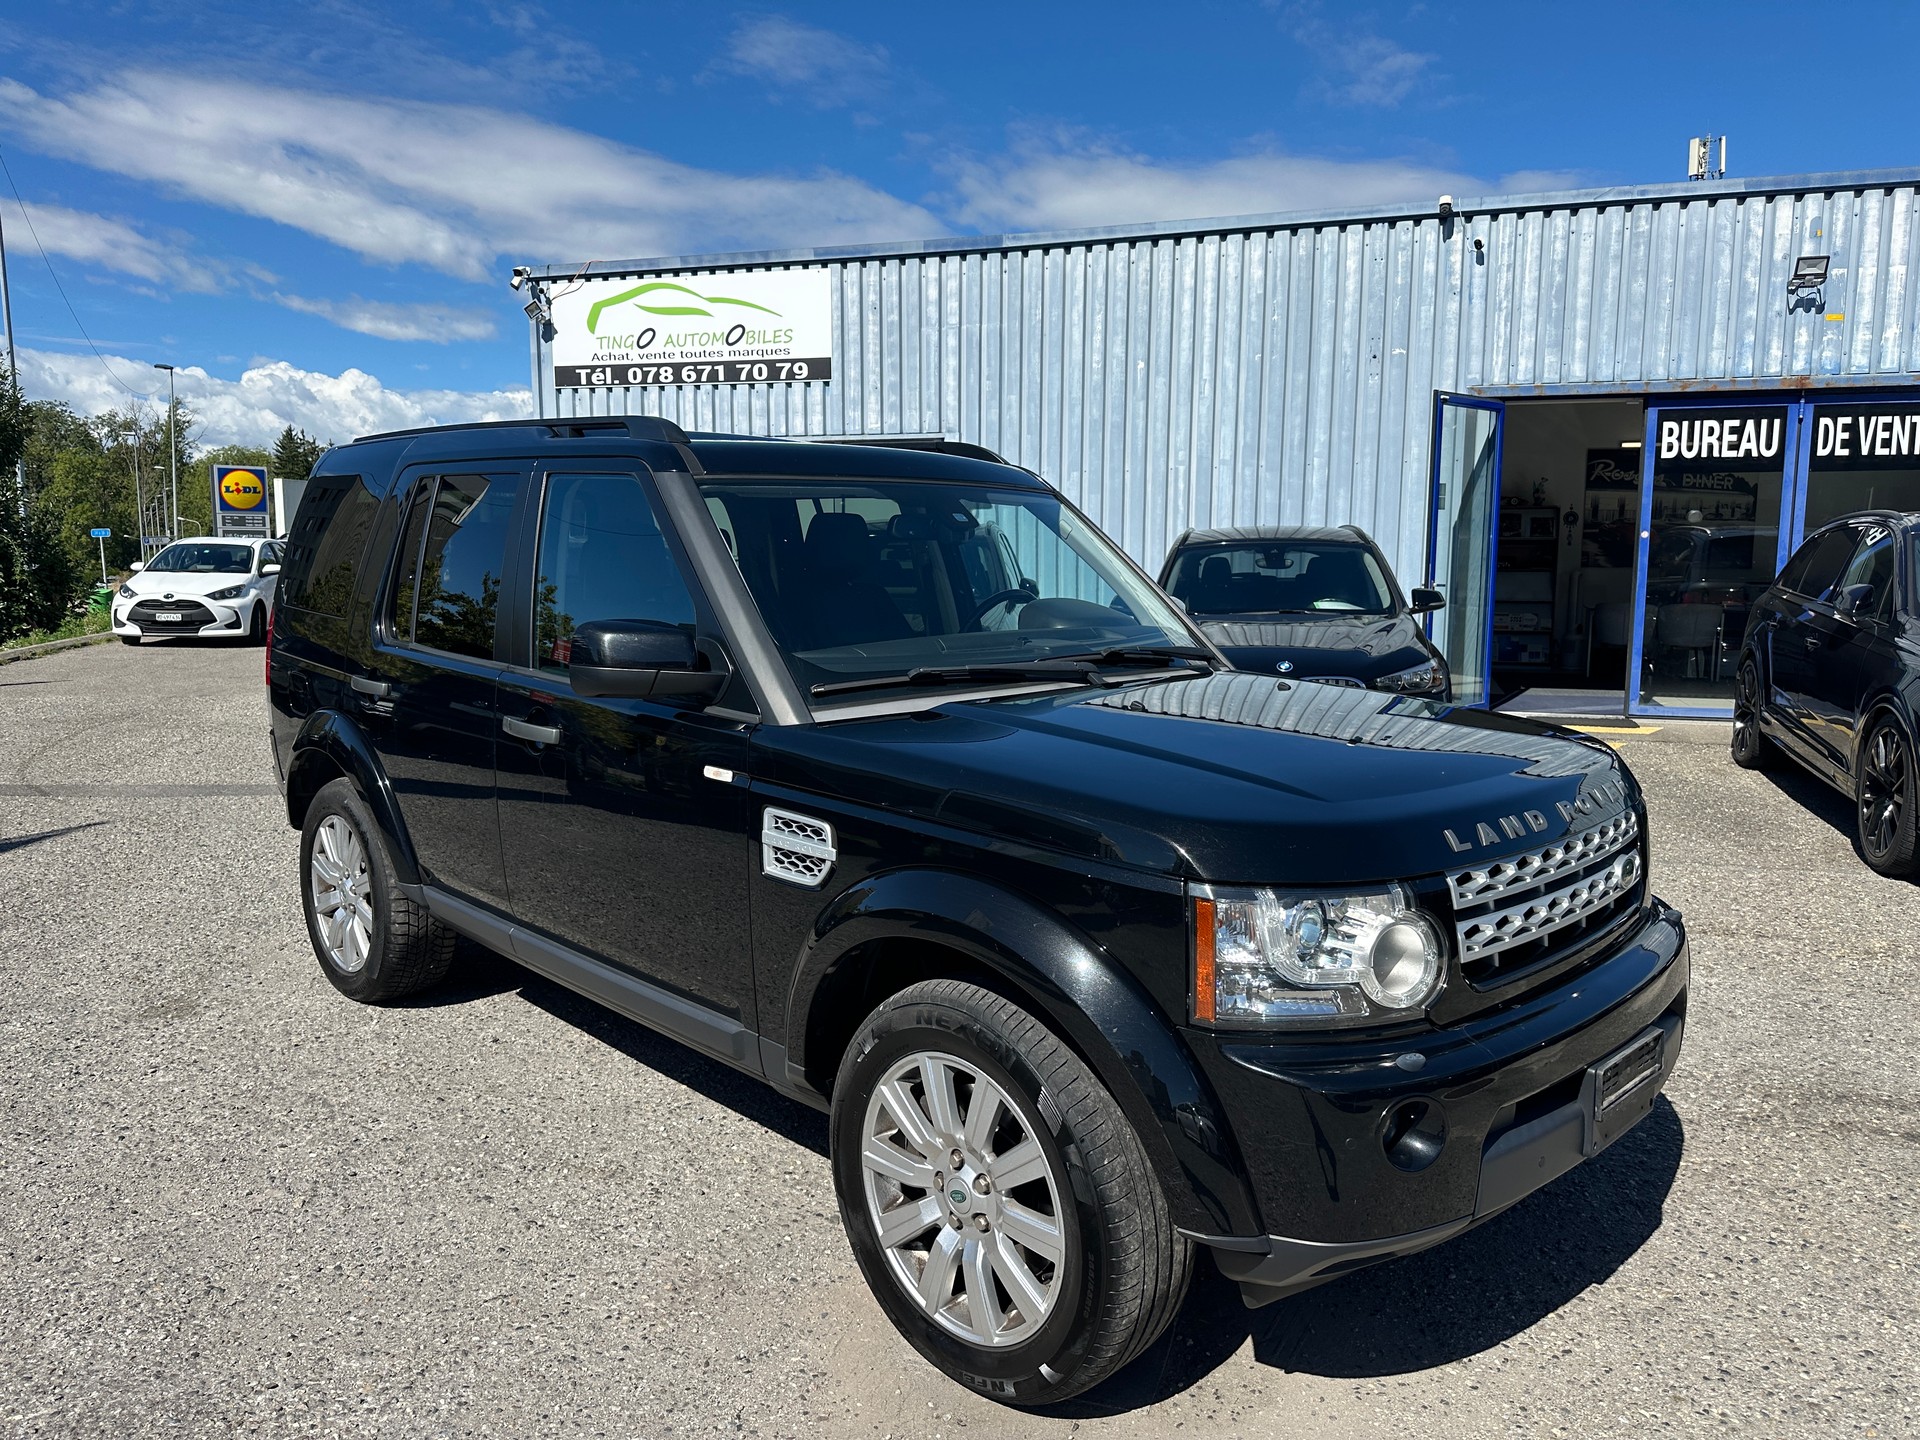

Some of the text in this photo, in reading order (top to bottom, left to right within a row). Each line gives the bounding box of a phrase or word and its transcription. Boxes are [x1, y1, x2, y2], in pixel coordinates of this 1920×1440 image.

[596, 323, 793, 350] TINGO AUTOMOBILES
[591, 347, 791, 362] Achat, vente toutes marques
[575, 361, 809, 385] Tél. 078 671 70 79
[1660, 418, 1781, 459] BUREAU
[1816, 416, 1852, 457] DE
[1682, 473, 1734, 490] DINER
[1443, 809, 1549, 852] LAND
